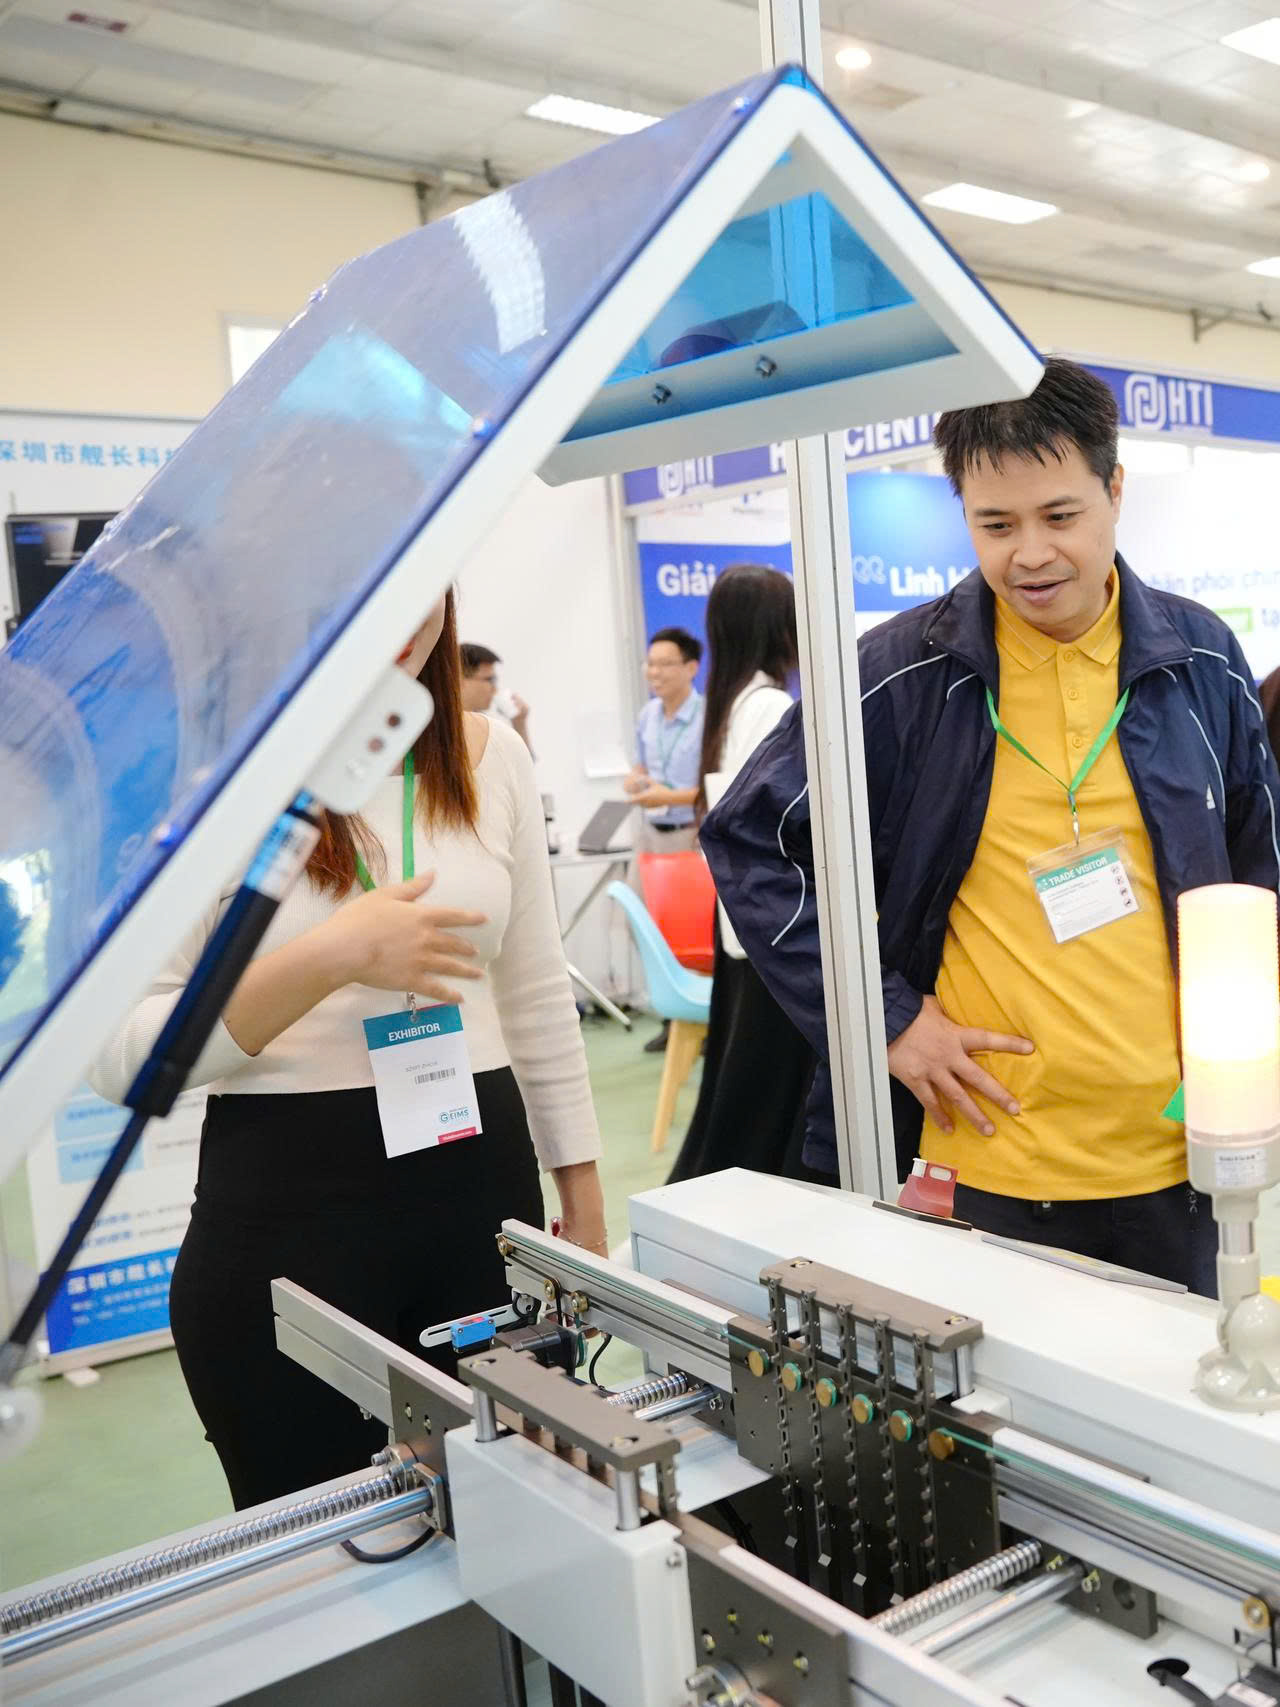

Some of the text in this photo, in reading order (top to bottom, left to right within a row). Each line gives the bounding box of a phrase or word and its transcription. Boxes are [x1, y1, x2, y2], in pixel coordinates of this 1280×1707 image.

[1167, 379, 1214, 426] HTI
[889, 565, 945, 597] Linh
[1048, 856, 1109, 887] TRADE VISITOR
[388, 1022, 441, 1042] EXHIBITOR
